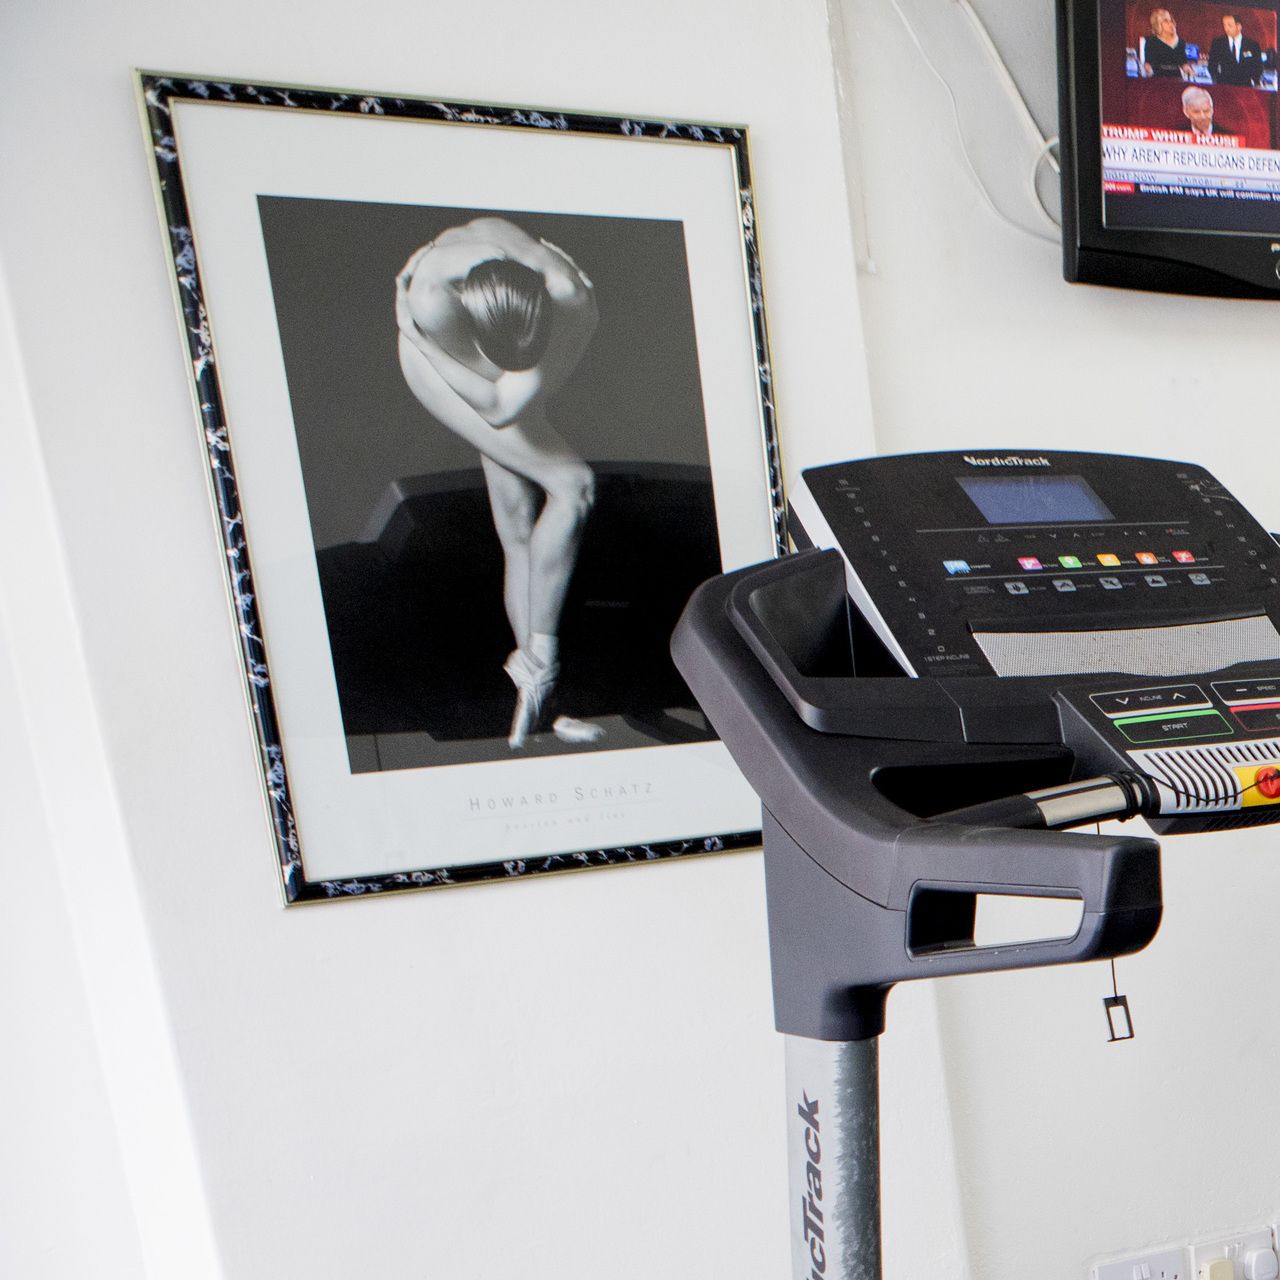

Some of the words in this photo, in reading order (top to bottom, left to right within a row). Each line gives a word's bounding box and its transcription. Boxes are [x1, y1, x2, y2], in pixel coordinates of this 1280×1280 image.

[1103, 127, 1149, 140] TRUMP
[1151, 130, 1192, 143] WHITE
[1196, 134, 1240, 148] HOUSE
[1103, 144, 1128, 161] WHY
[1132, 147, 1169, 162] AREN'T
[1173, 150, 1246, 168] REPUBLICANS
[963, 455, 1051, 467] NordicTrack
[1256, 684, 1276, 692] SPEED
[1162, 722, 1190, 732] START
